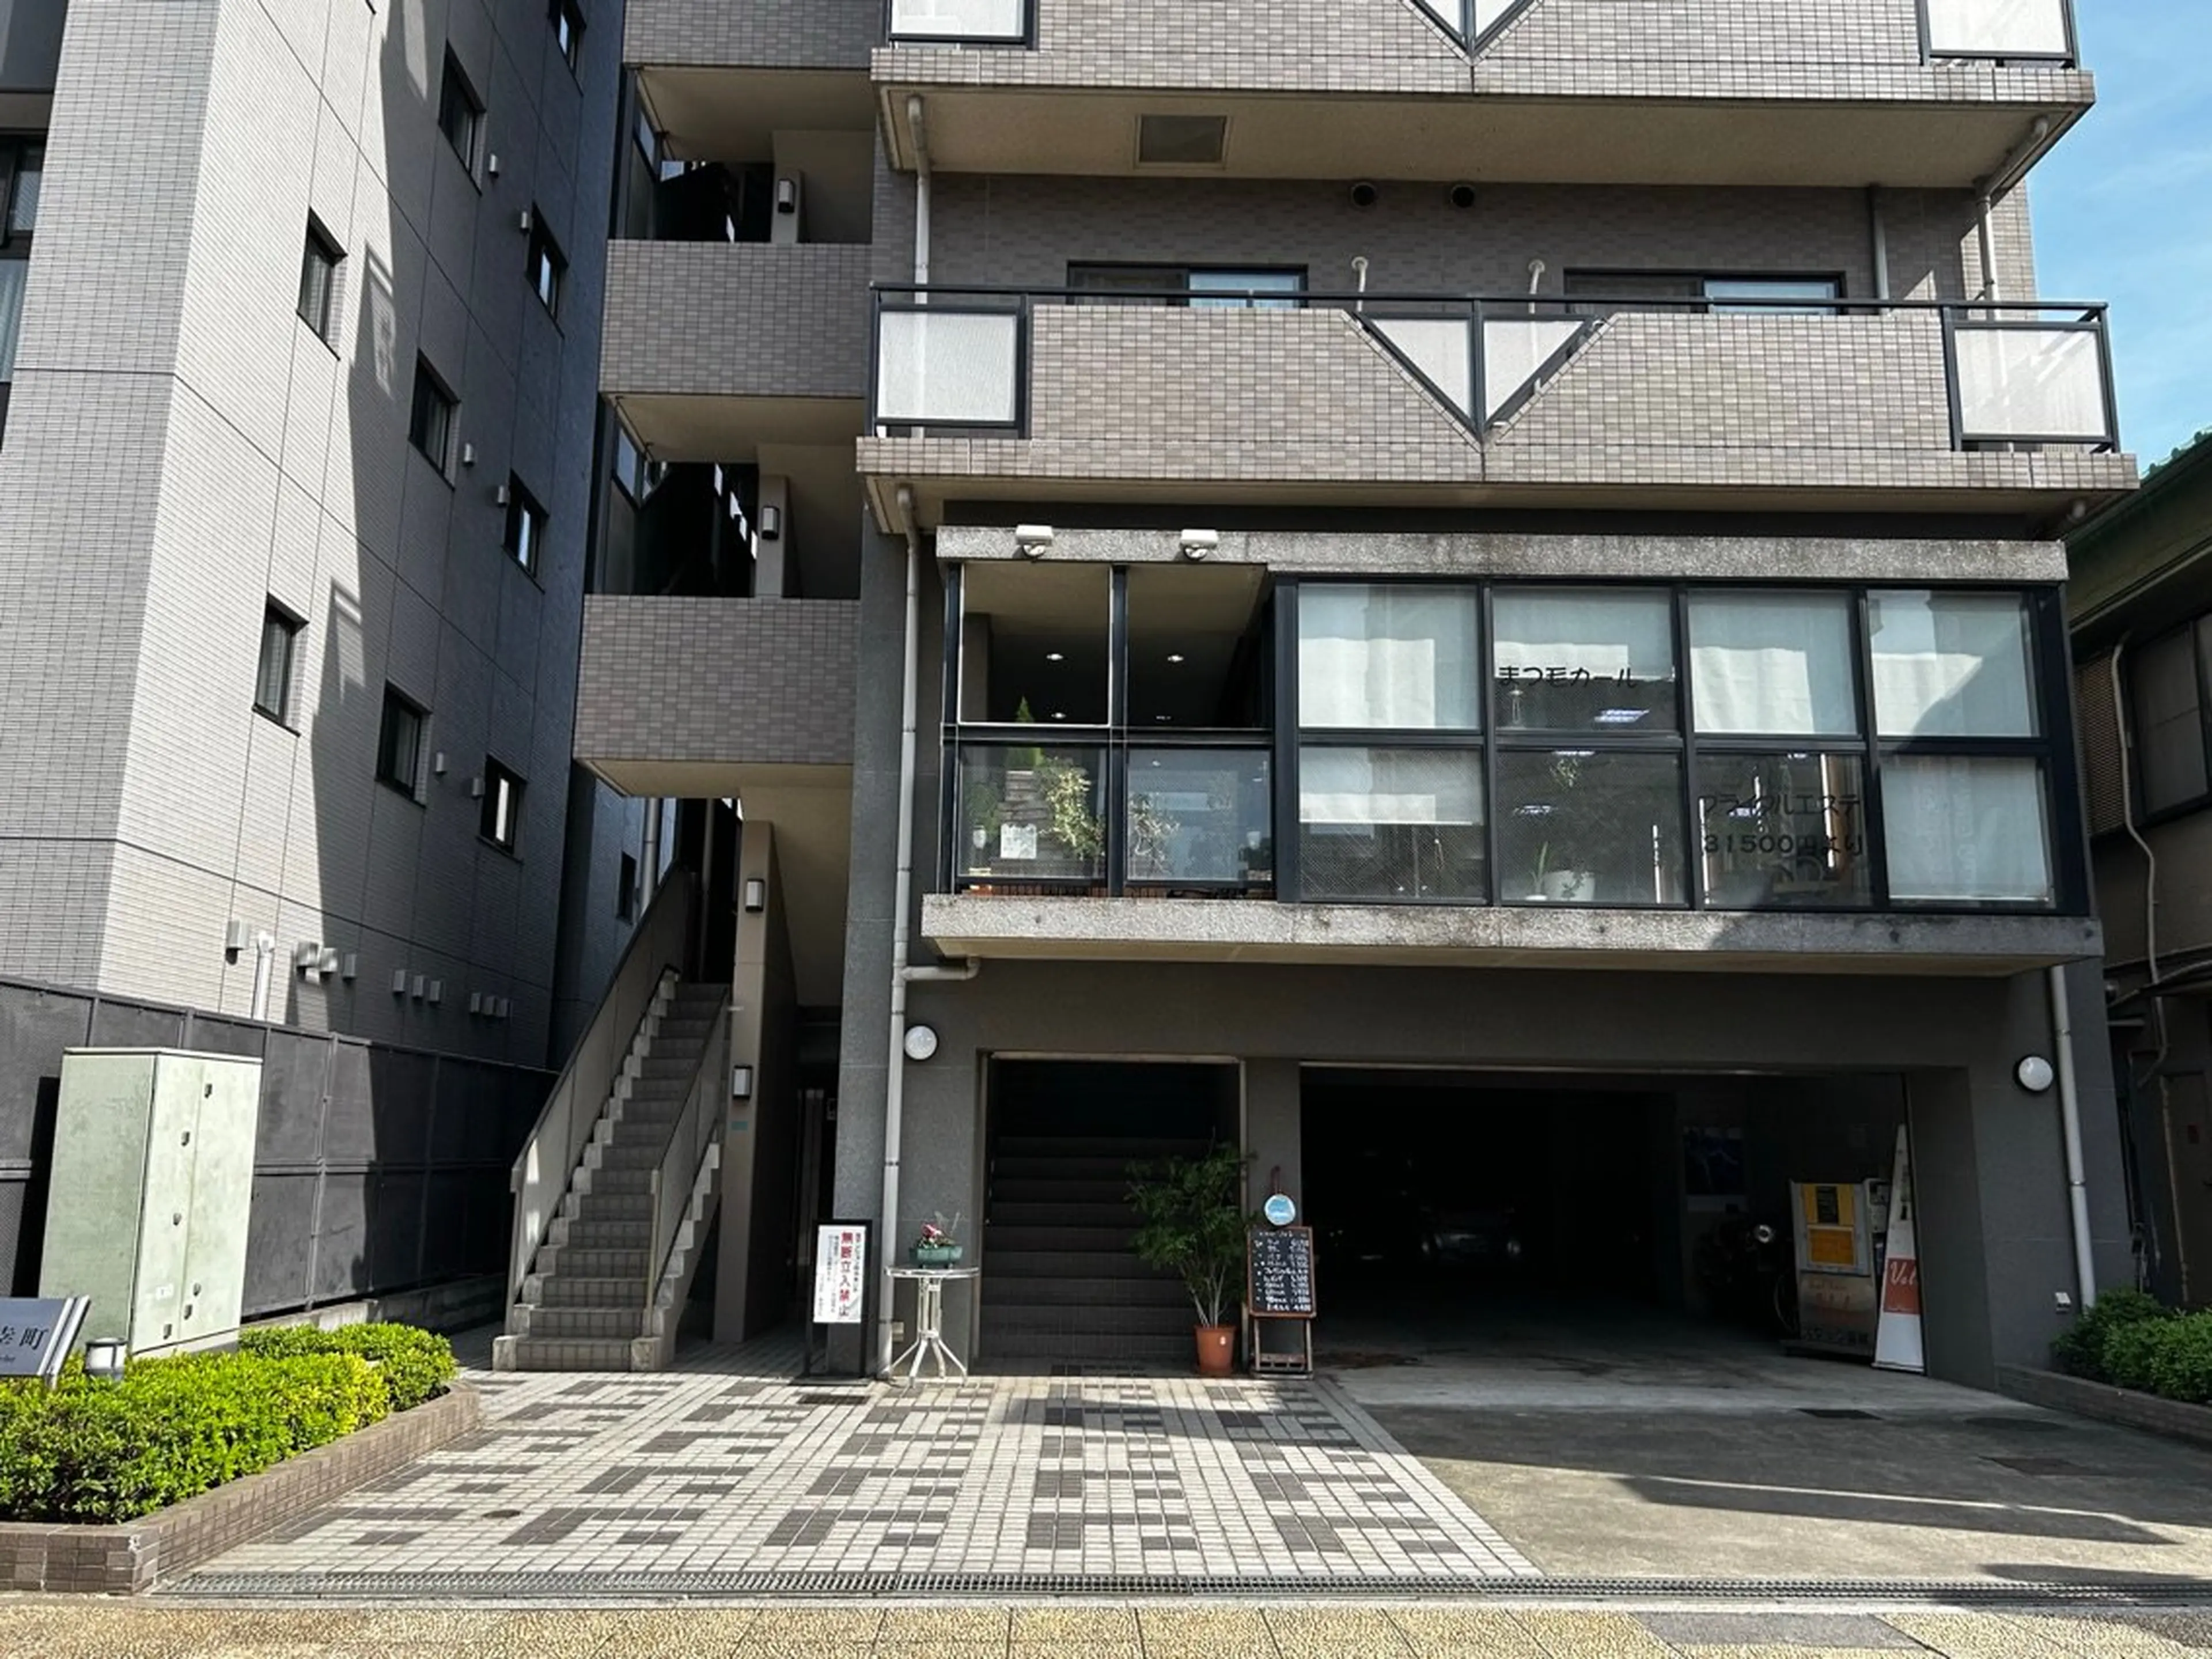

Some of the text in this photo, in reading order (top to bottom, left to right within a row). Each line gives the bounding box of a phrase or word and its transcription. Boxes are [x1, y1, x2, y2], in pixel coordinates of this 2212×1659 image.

[1499, 666, 1637, 688] まつ毛カール
